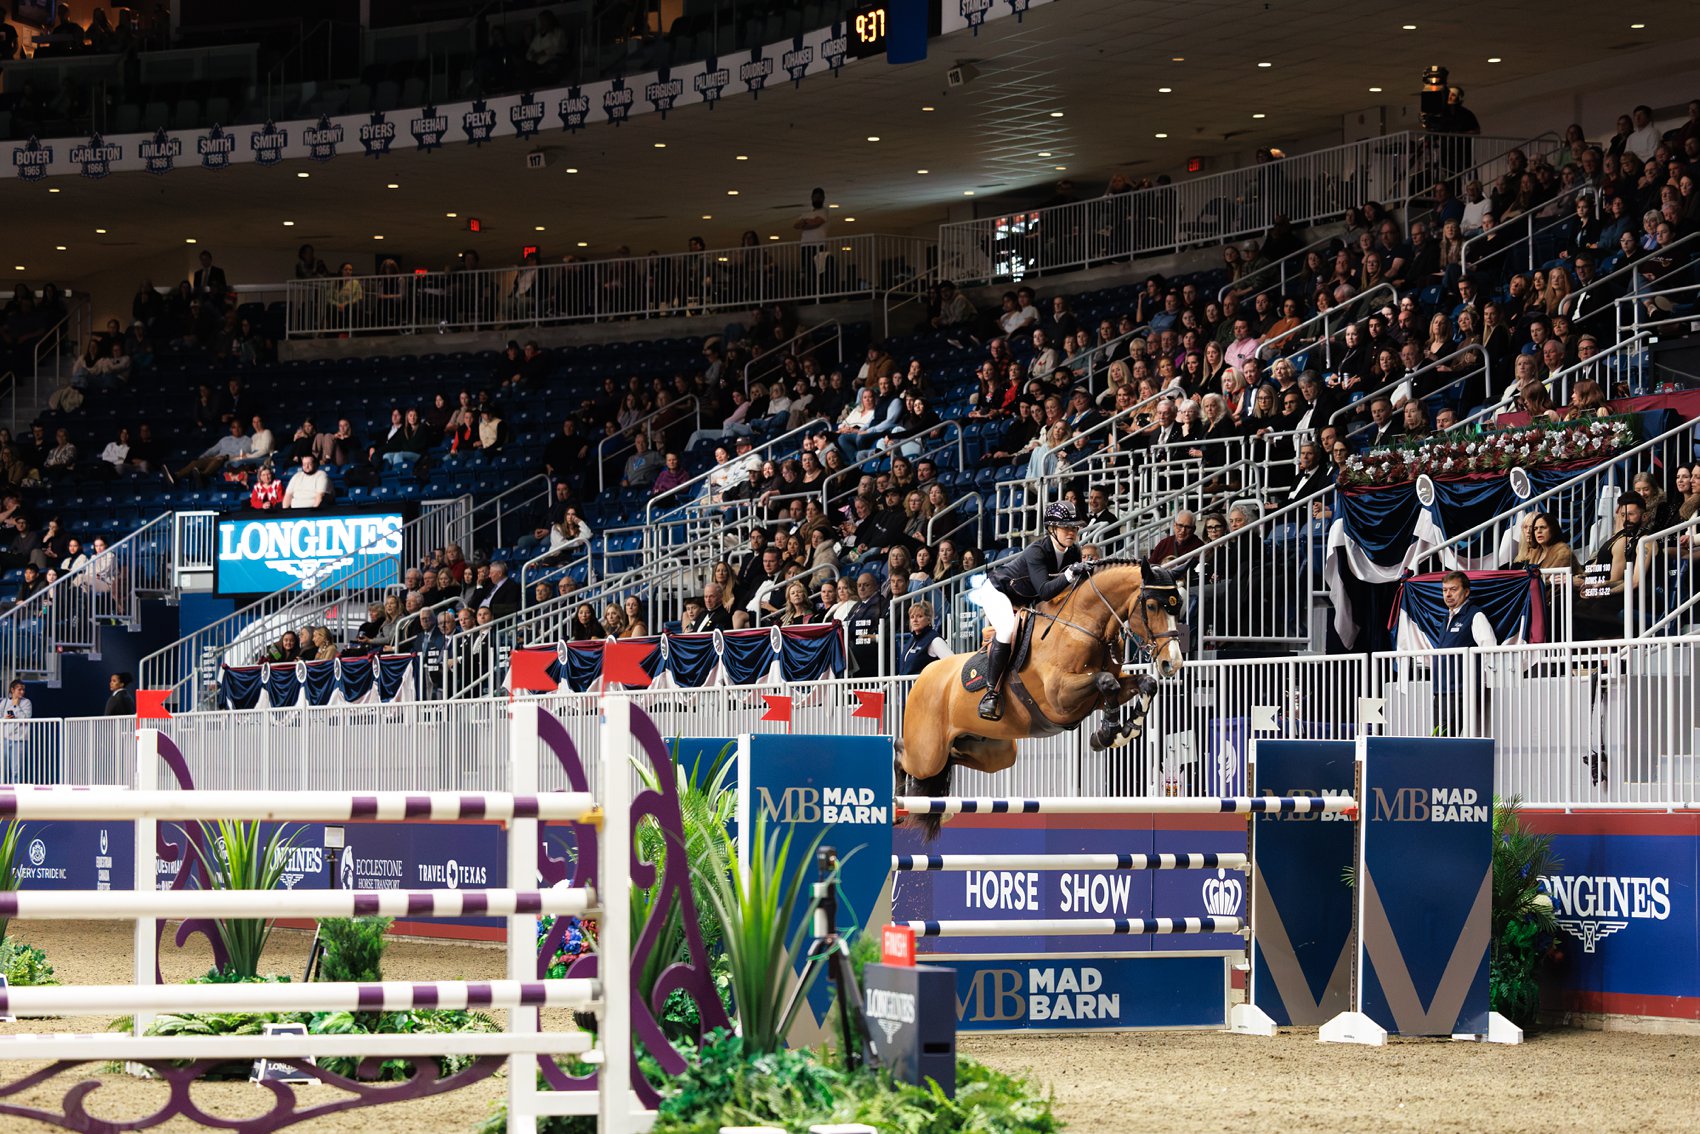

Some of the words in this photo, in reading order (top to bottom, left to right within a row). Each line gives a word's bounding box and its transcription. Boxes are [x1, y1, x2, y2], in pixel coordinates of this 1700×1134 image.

[856, 9, 885, 43] 9:37
[823, 36, 847, 58] ANDERSO
[695, 70, 728, 91] PALMATEER
[605, 90, 632, 106] ACOMB
[647, 81, 682, 100] FERGUSON
[561, 97, 587, 114] EVANS
[658, 98, 670, 109] 1972
[466, 112, 492, 128] PELYK
[512, 104, 543, 121] GLENNIE
[362, 123, 394, 139] BYERS
[412, 117, 446, 134] MEEHAN
[254, 135, 284, 149] SMITH
[304, 128, 343, 145] McKENNY
[371, 139, 385, 150] 1967
[71, 147, 120, 162] CARLETON
[142, 143, 179, 157] IMLACH
[200, 139, 231, 154] SMITH
[16, 151, 50, 165] BOYER
[208, 154, 223, 164] 1966
[530, 155, 541, 166] 117
[24, 165, 40, 176] 1965
[87, 163, 104, 173] 1966
[219, 516, 402, 560] LONGINES
[823, 787, 875, 805] MAD
[1372, 787, 1430, 822] MB
[1432, 788, 1477, 805] MAD
[756, 787, 821, 823] MB
[1431, 805, 1488, 822] BARN
[823, 806, 887, 824] BARN
[37, 868, 59, 879] STRIDE
[356, 859, 403, 877] ECCLESTONE
[418, 864, 446, 882] TRAVEL
[459, 866, 486, 884] TEXAS
[358, 878, 373, 889] HORSE
[374, 879, 400, 890] TRANSPORT
[966, 871, 1038, 911] HORSE
[1060, 873, 1131, 914] SHOW
[1536, 875, 1671, 920] NGINES
[884, 931, 908, 958] FINISH
[1029, 968, 1102, 993] MAD
[866, 988, 915, 1024] LONGINES
[1029, 993, 1120, 1020] BARN
